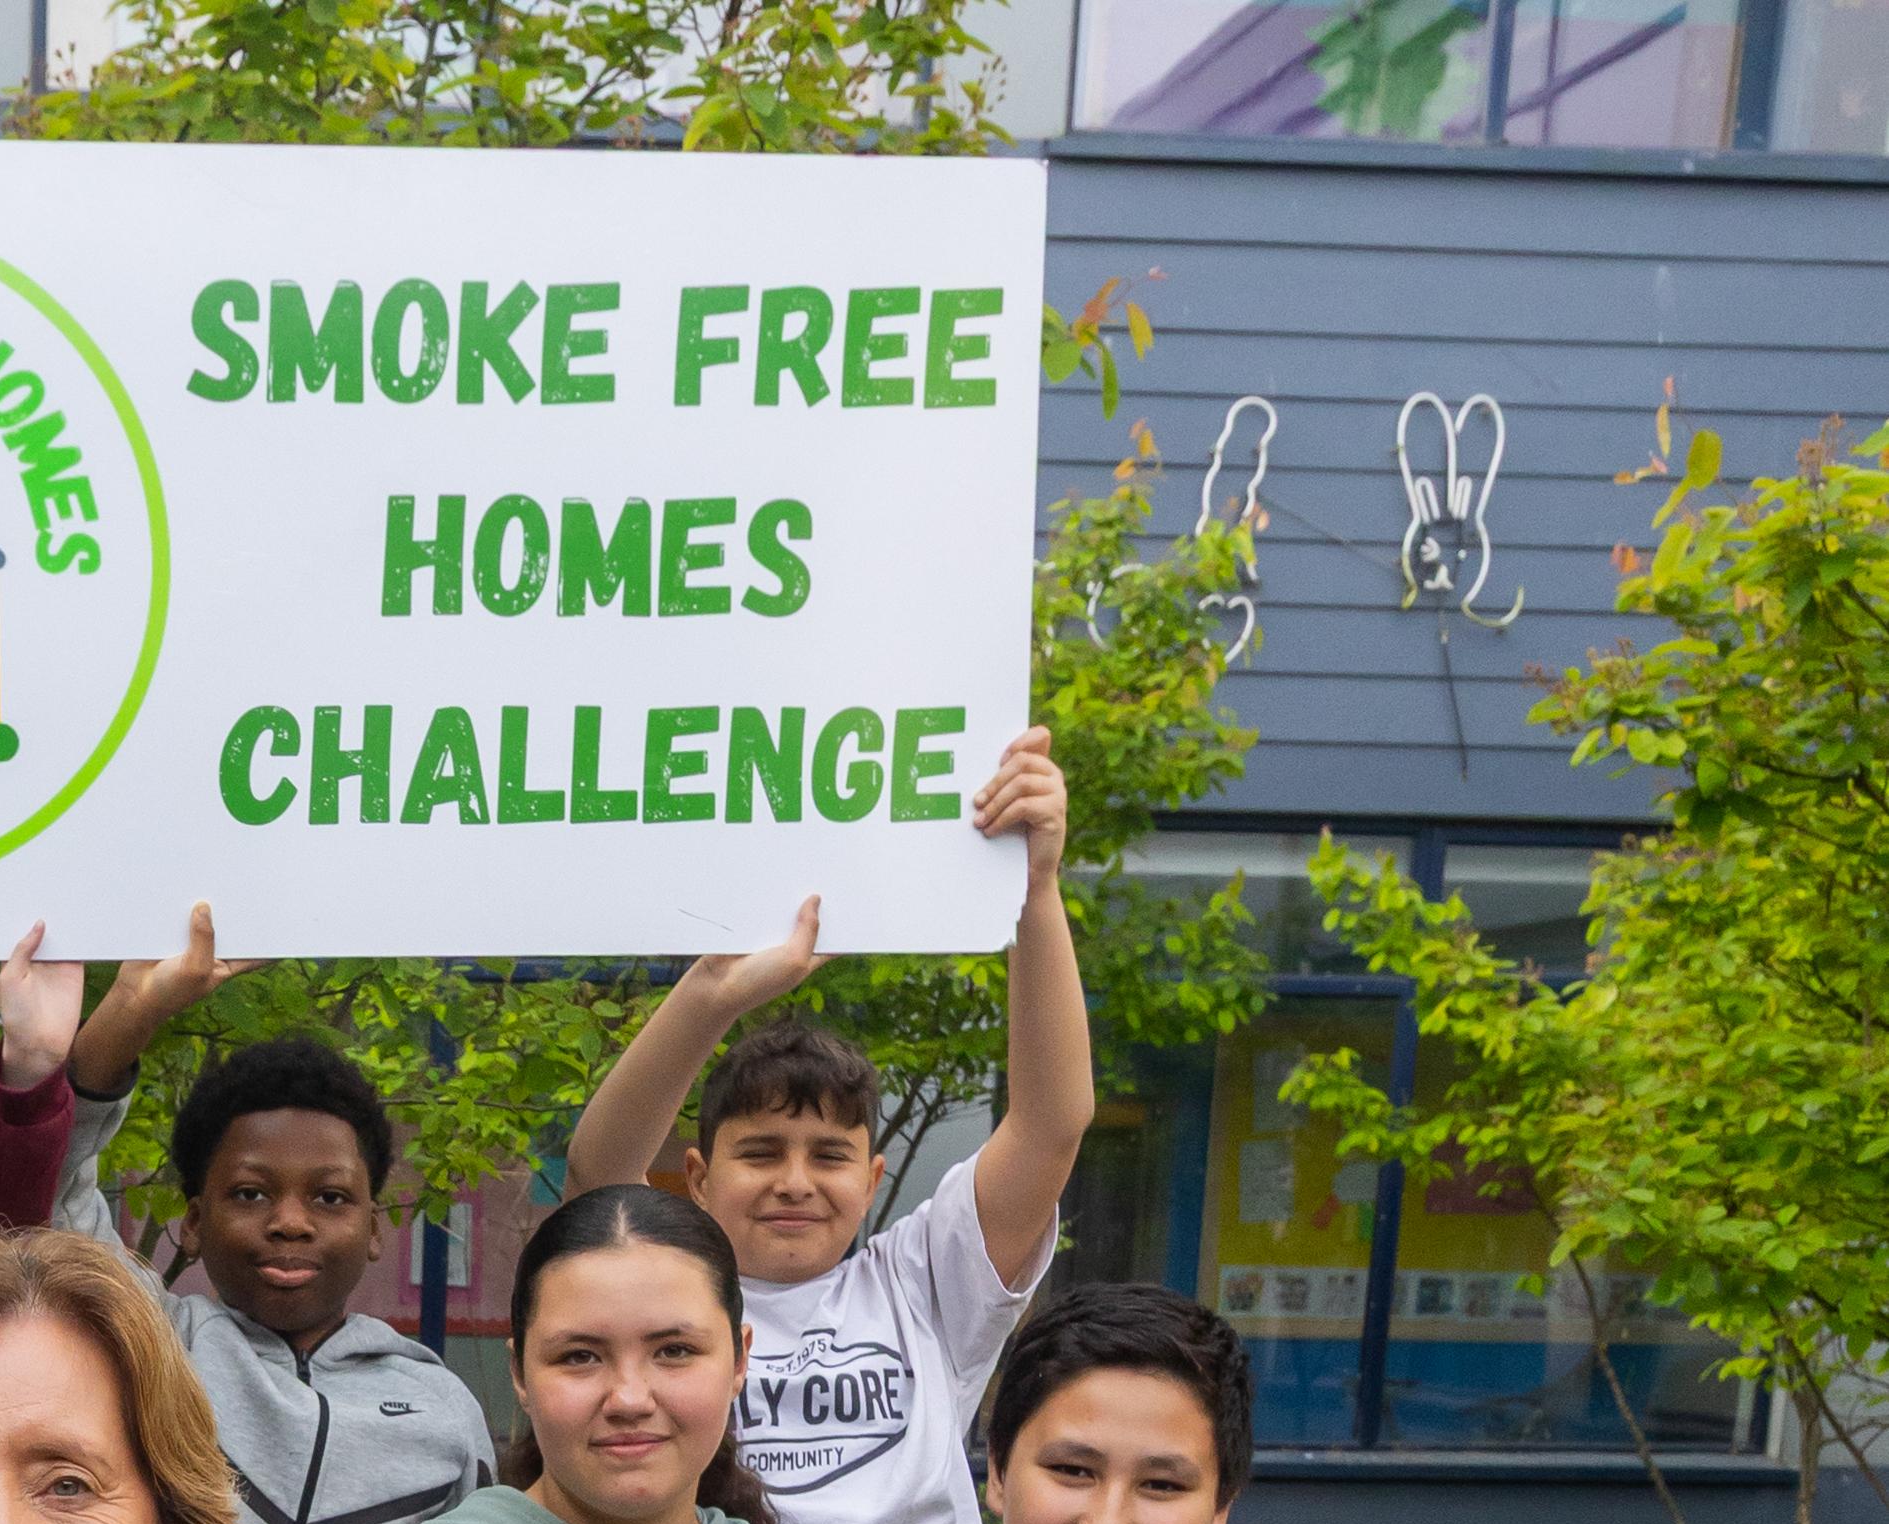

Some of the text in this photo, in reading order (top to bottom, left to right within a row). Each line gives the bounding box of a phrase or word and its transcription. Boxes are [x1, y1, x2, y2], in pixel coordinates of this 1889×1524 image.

[186, 278, 1004, 409] SMOKE FREE
[381, 493, 813, 618] HOMES
[218, 704, 967, 826] CHALLENGE
[746, 1447, 844, 1473] COMMUNITY
